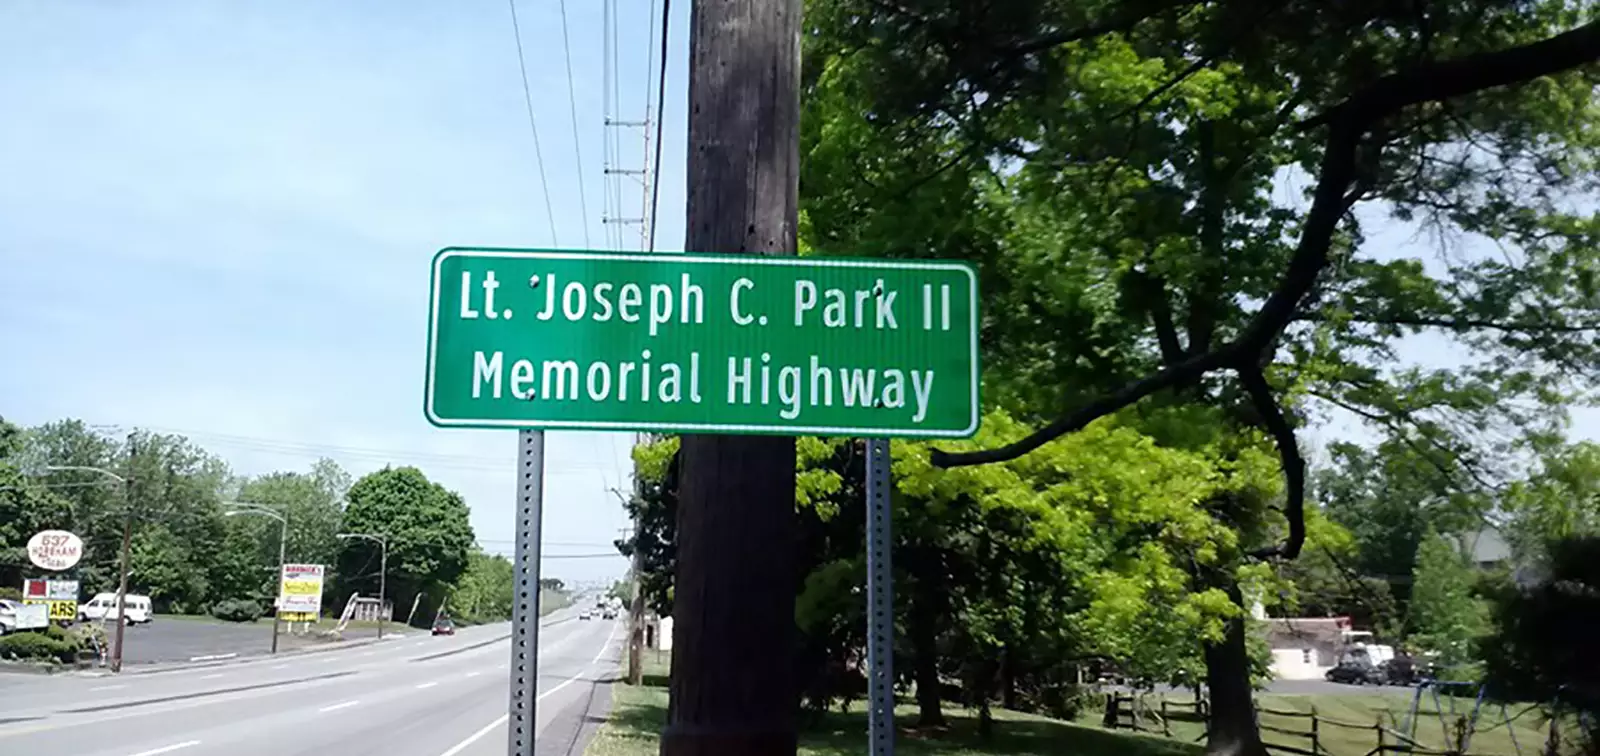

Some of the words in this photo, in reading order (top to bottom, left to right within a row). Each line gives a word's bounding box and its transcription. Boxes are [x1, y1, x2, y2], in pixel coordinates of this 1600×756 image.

[460, 271, 512, 319] Lt.
[536, 272, 703, 336] Joseph
[730, 278, 767, 326] C.
[795, 279, 898, 329] Park
[923, 283, 950, 331] II
[472, 351, 701, 403] Memorial
[728, 352, 934, 423] Highway
